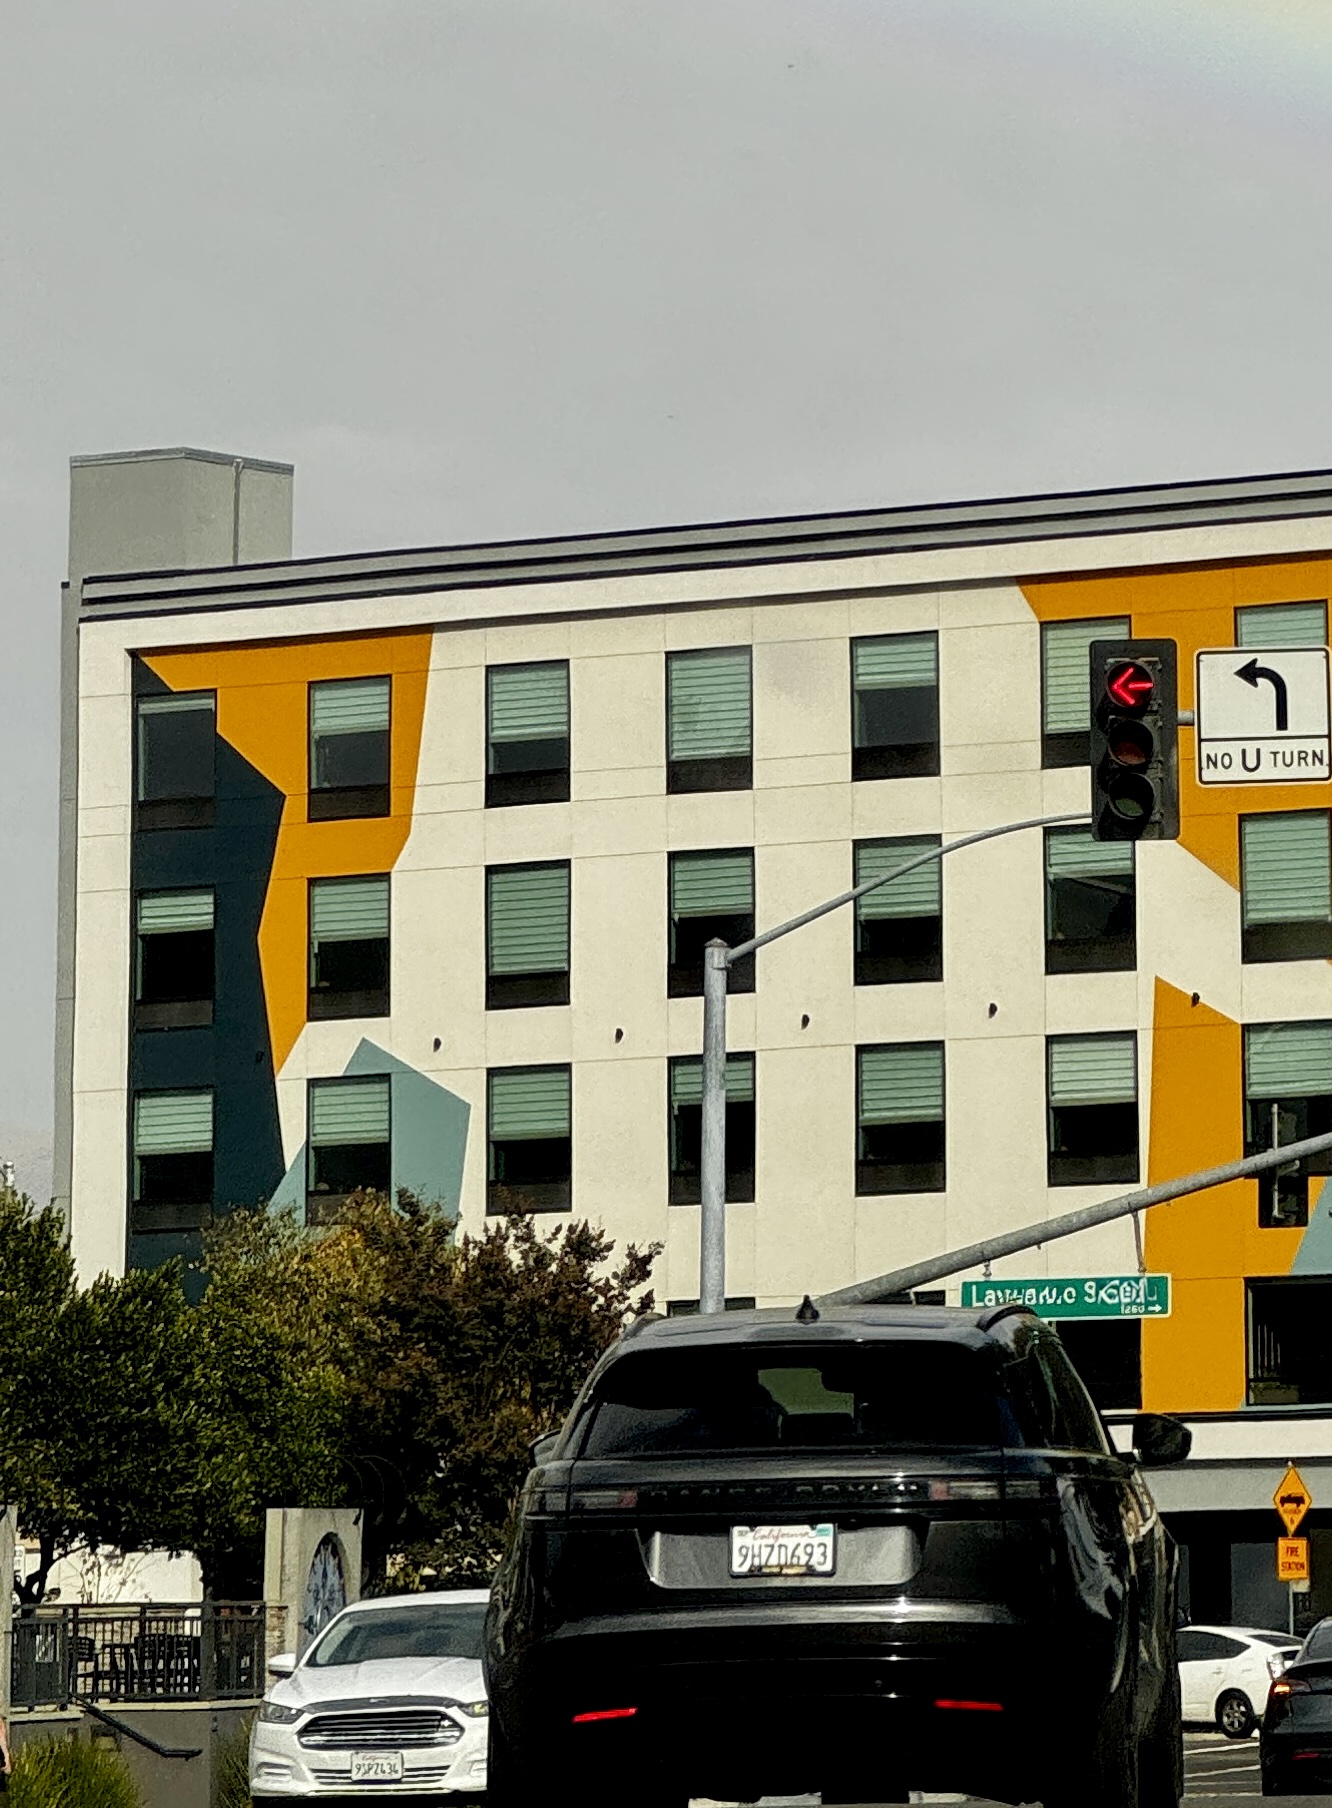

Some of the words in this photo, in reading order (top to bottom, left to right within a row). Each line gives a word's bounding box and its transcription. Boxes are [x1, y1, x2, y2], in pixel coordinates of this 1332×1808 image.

[1205, 752, 1233, 770] NO
[1241, 747, 1261, 773] U
[1269, 749, 1324, 768] TURN
[1285, 1546, 1299, 1557] FIRE
[1281, 1561, 1305, 1572] STATION
